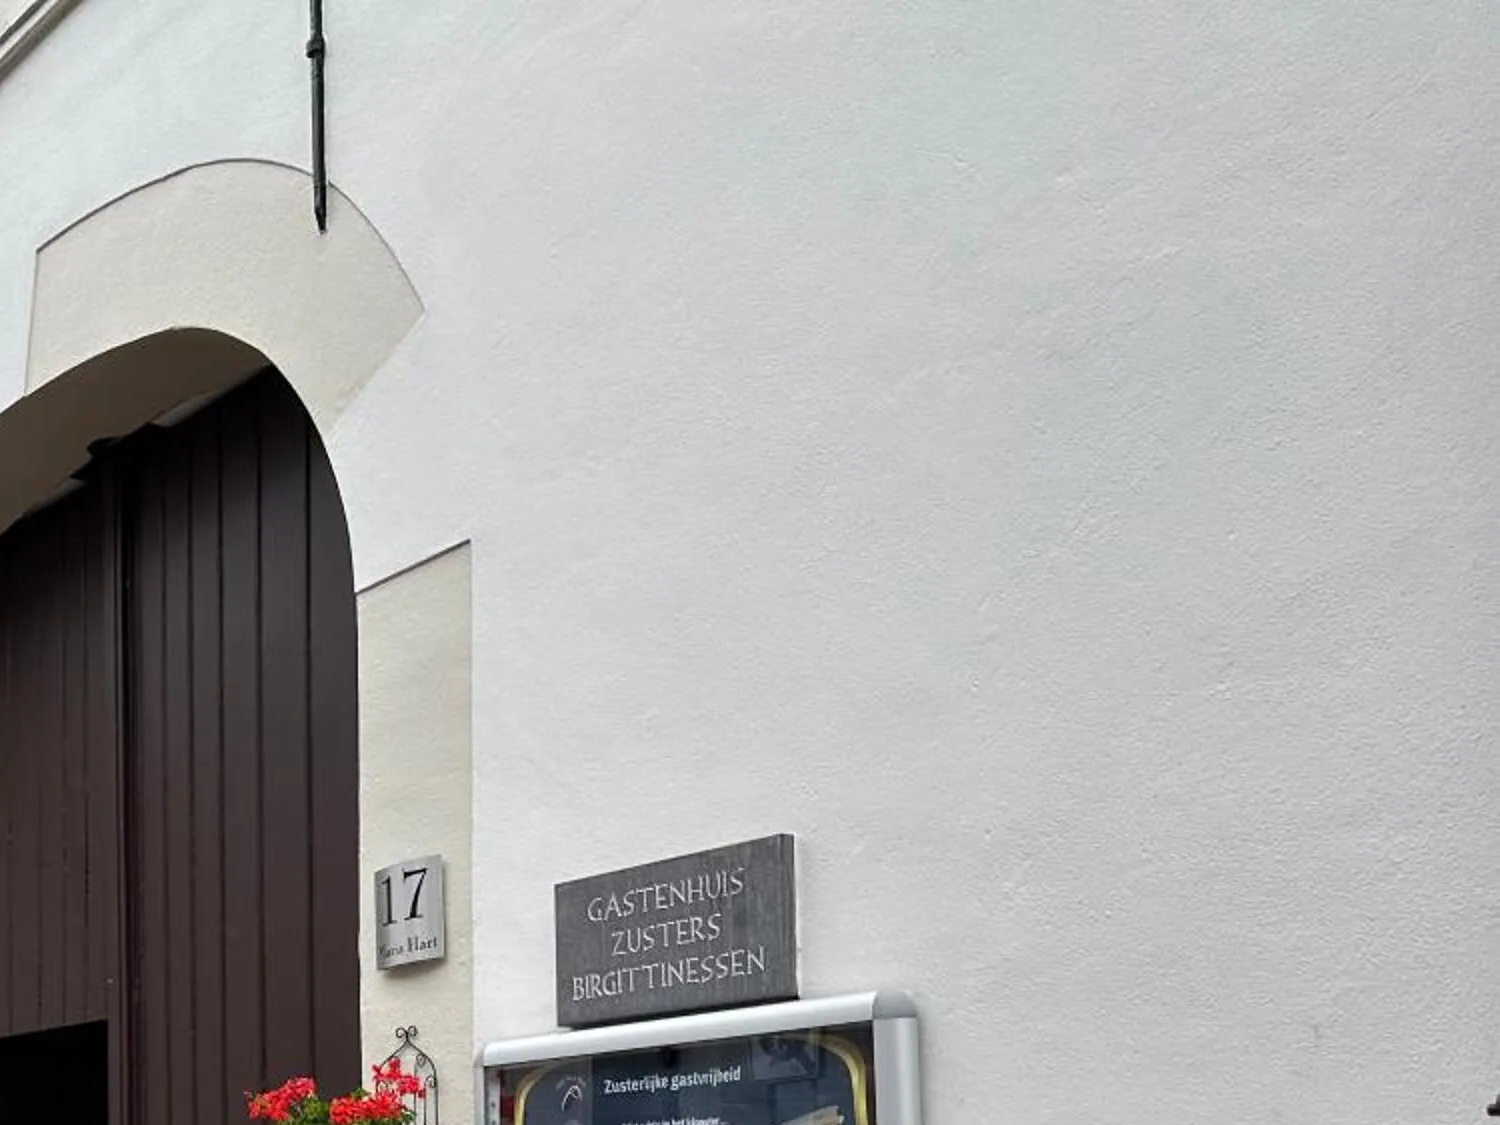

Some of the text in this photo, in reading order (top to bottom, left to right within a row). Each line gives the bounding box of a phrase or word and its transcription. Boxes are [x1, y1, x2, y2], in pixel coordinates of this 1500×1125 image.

[381, 867, 428, 927] 17
[587, 867, 745, 922] GASTENHUIS
[611, 913, 722, 956] ZUSTERS
[572, 946, 765, 1001] BIRGITTINESSEN
[604, 1073, 669, 1094] Zusterlijke
[670, 1065, 742, 1091] gastvrijheid
